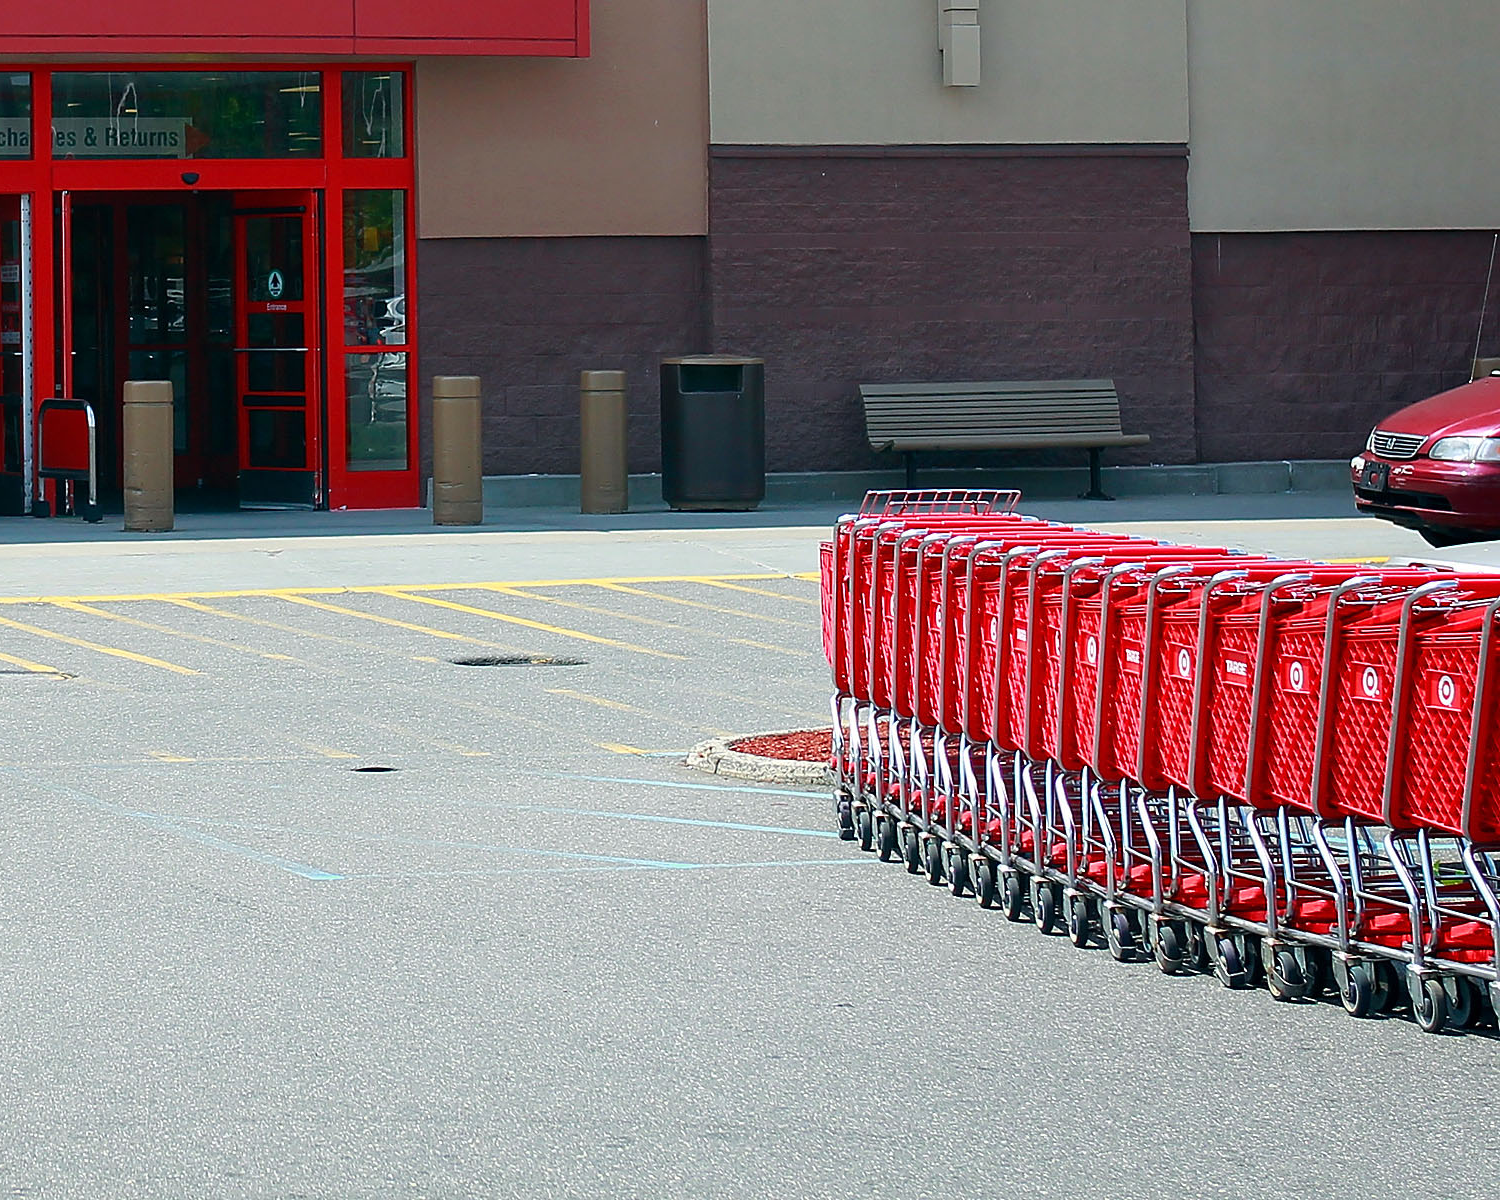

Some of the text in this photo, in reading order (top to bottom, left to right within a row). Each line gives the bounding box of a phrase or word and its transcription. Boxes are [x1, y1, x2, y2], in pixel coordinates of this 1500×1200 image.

[84, 127, 98, 147] &
[105, 127, 179, 147] Returns
[1225, 659, 1248, 676] TARGE
